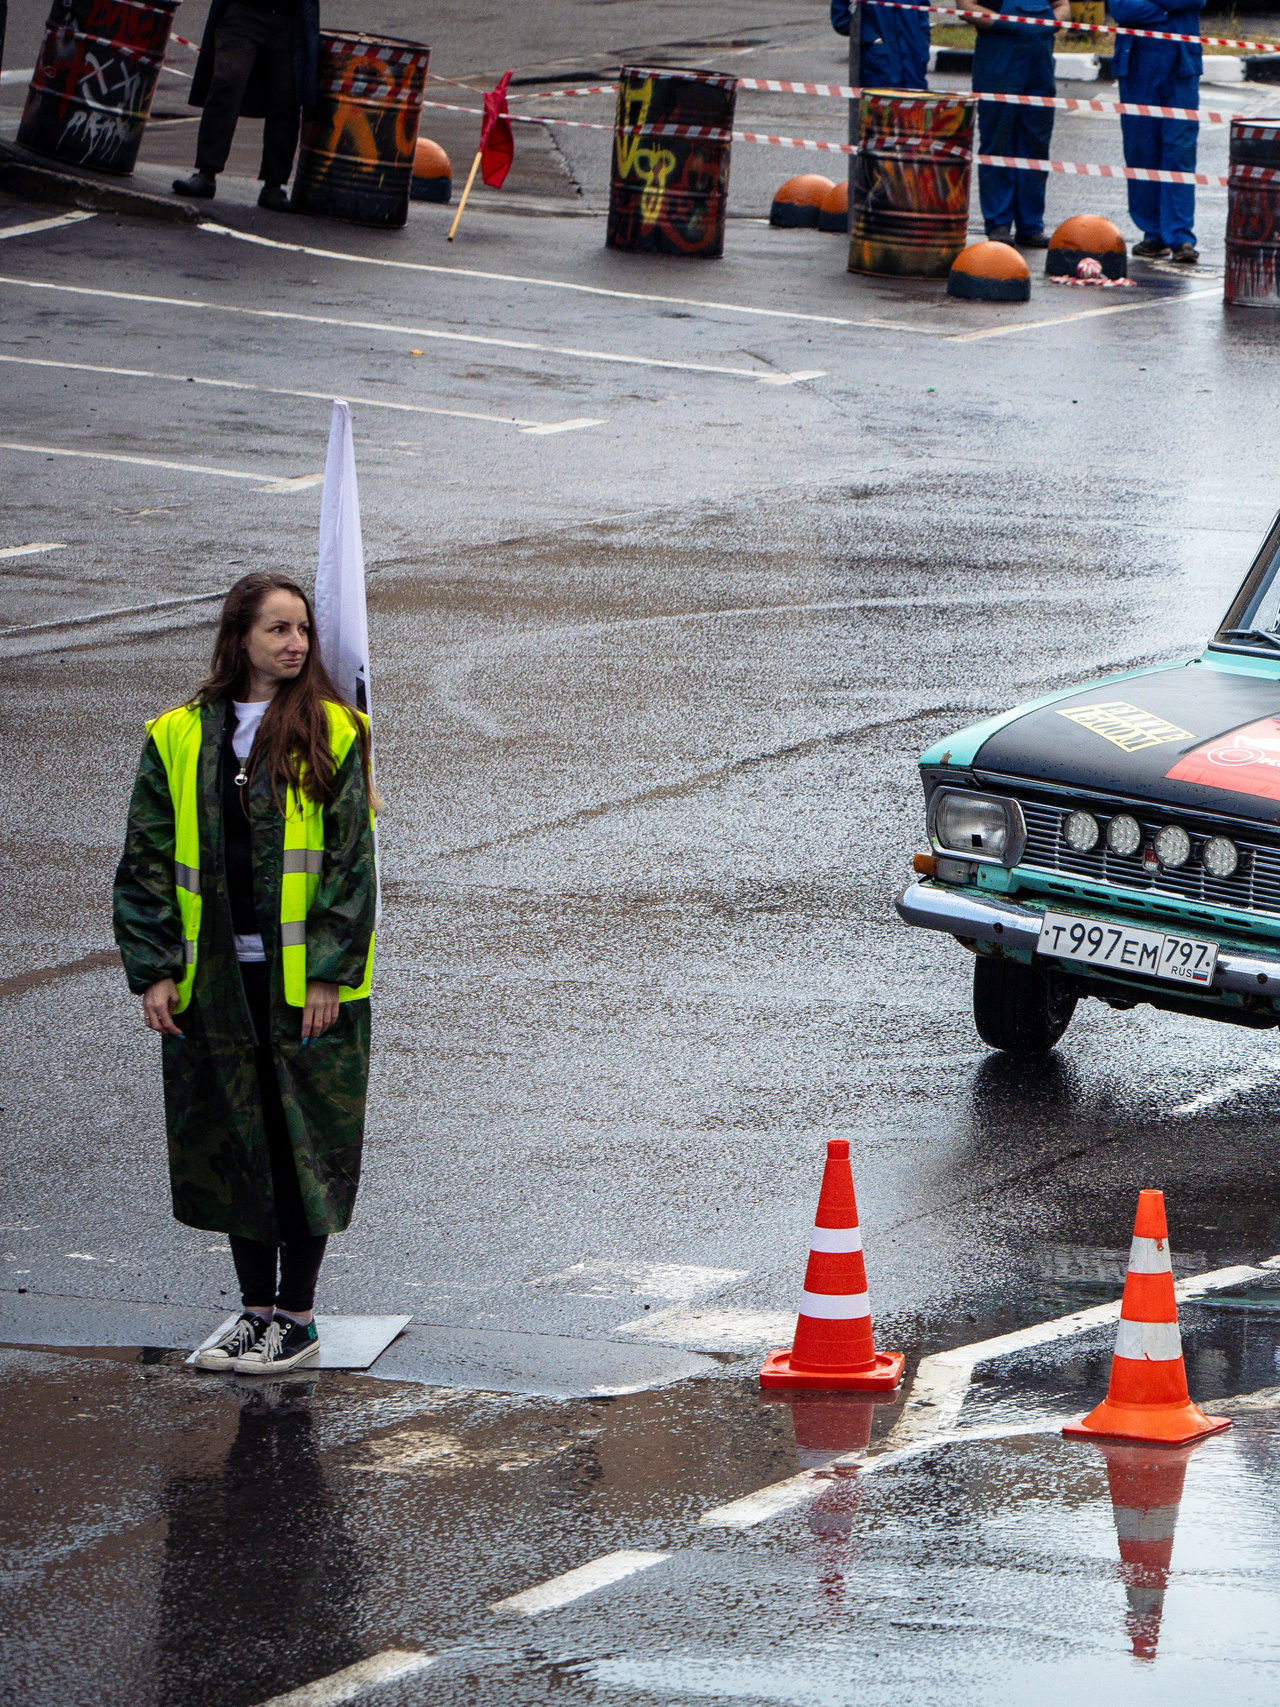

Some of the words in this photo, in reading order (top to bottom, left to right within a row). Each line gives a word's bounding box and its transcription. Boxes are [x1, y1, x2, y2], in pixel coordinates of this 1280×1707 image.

[1064, 708, 1158, 749] 1500M
[1098, 703, 1191, 741] ELITE
[1165, 938, 1208, 968] 797
[1171, 965, 1193, 978] RUS
